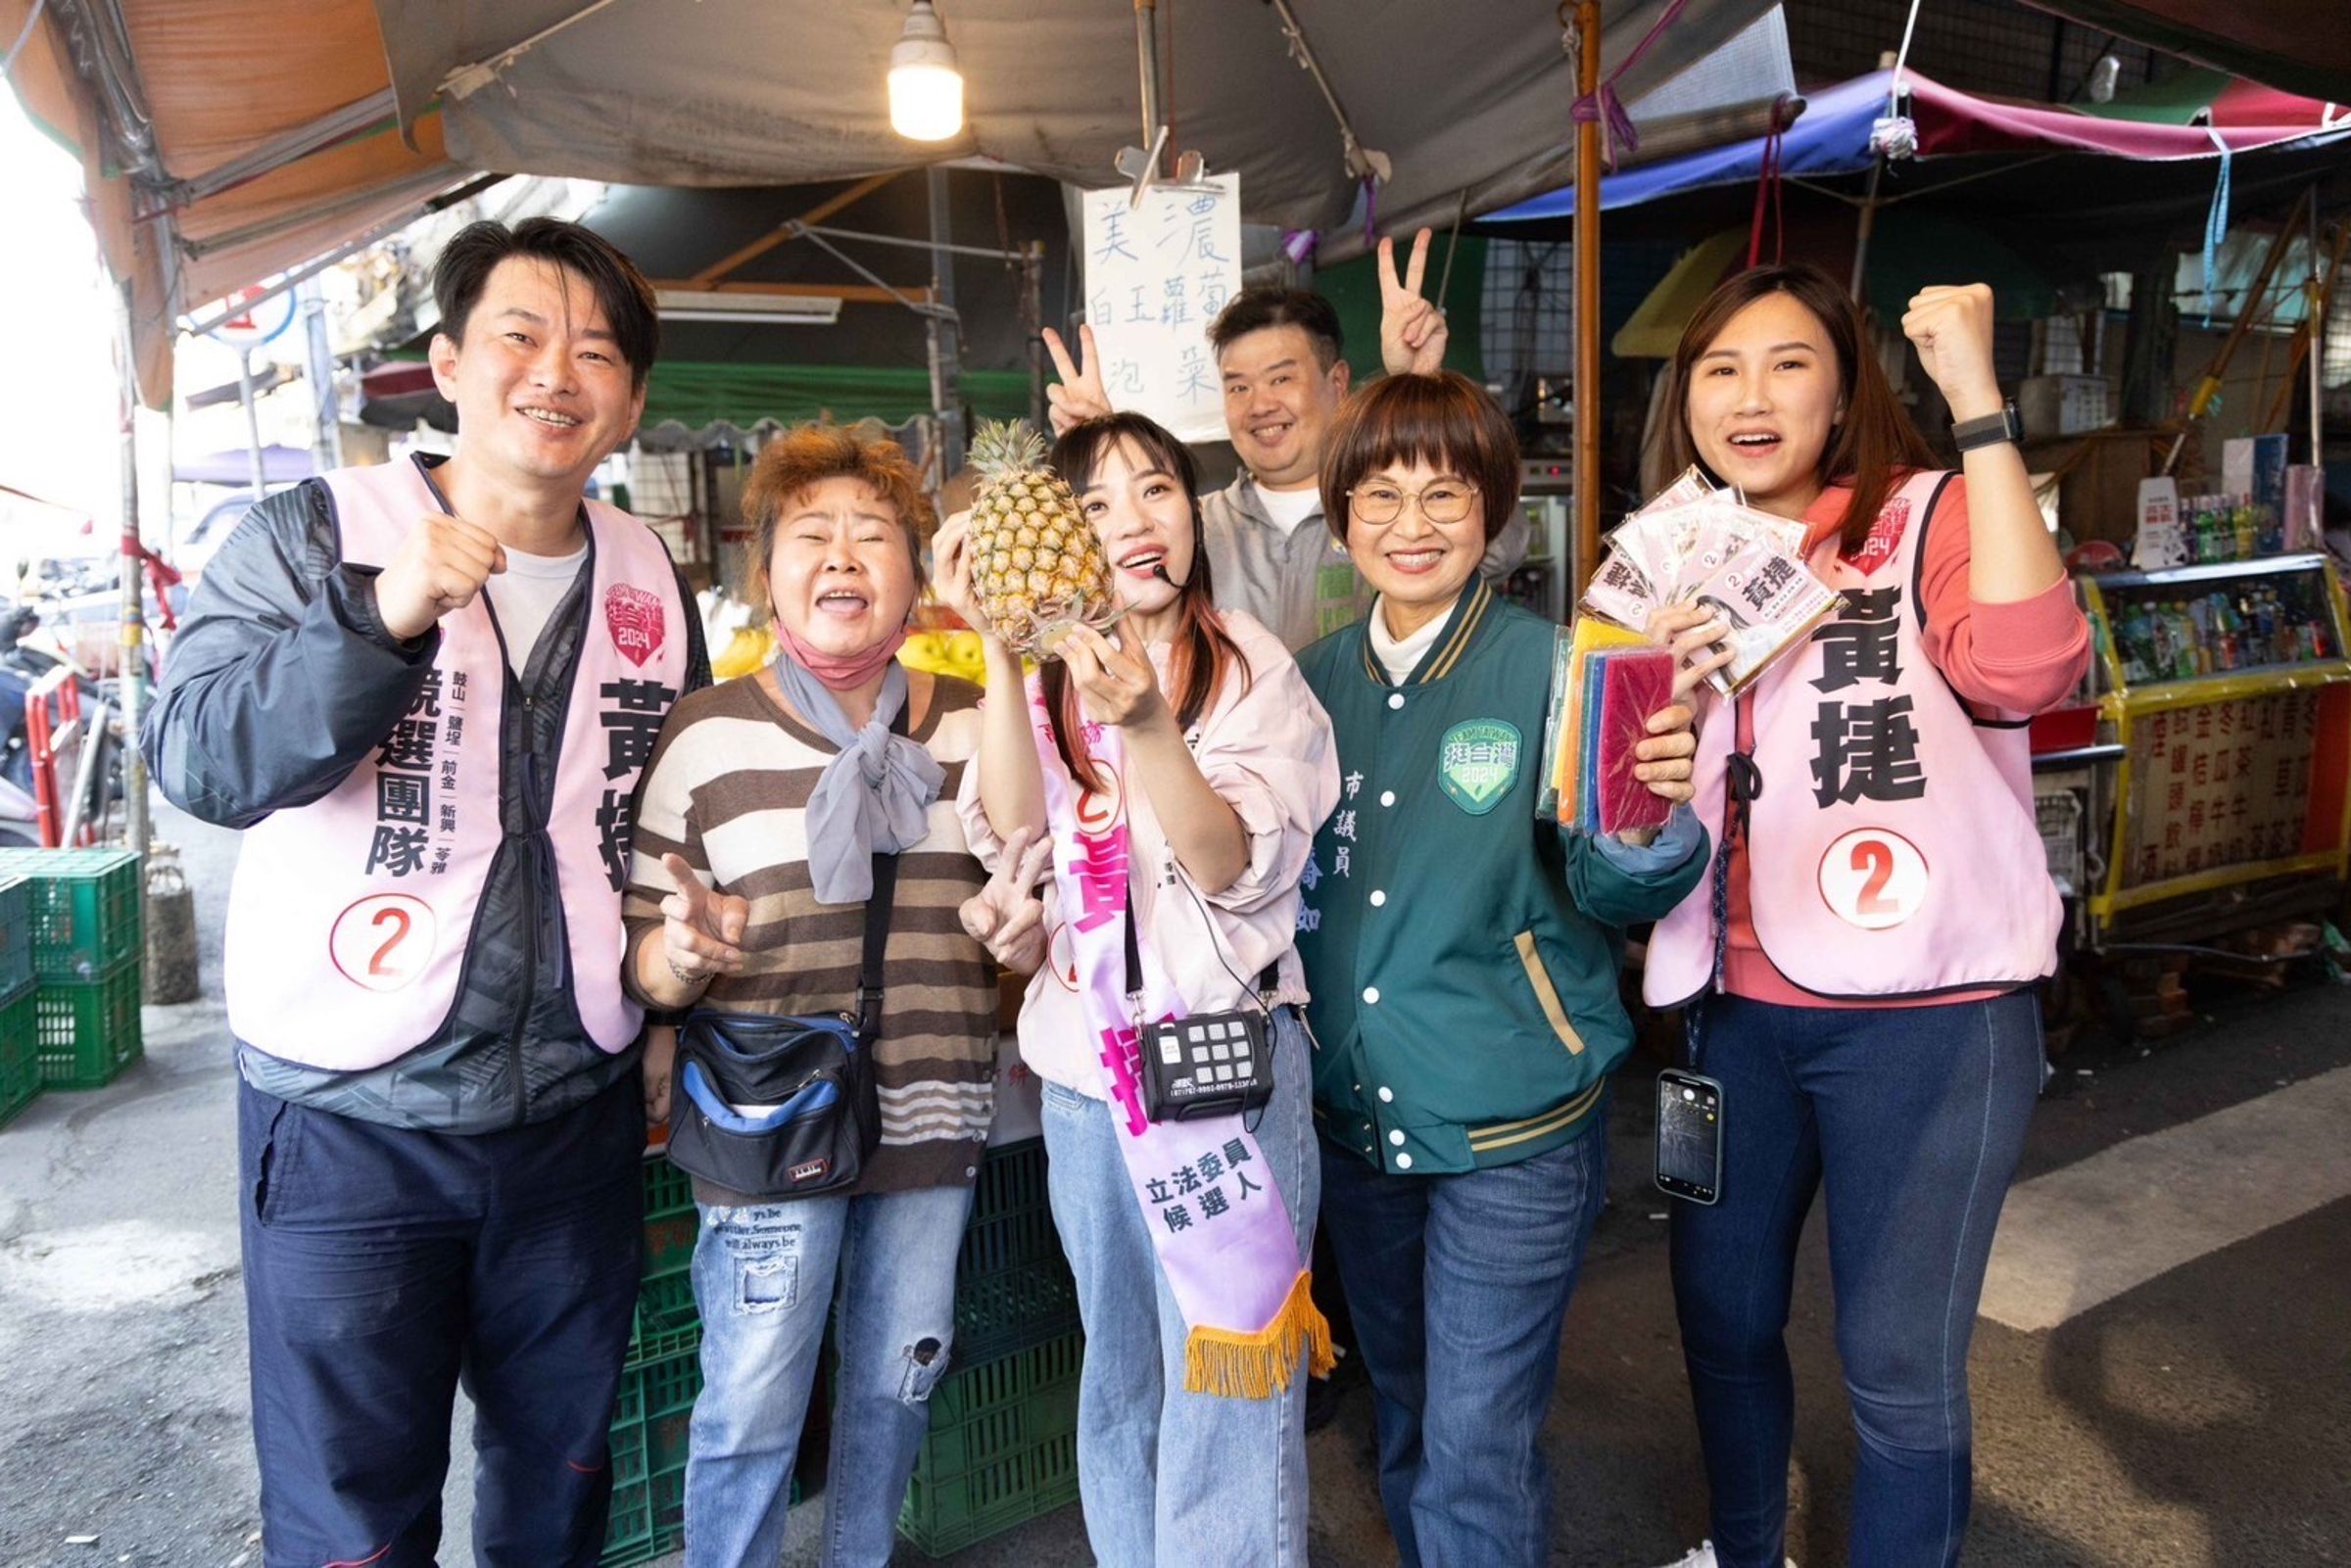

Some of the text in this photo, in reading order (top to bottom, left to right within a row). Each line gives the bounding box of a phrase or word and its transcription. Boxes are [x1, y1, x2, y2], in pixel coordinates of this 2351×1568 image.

[1094, 195, 1229, 265] 美濃
[1108, 346, 1218, 404] 泡菜
[1728, 575, 1741, 587] 2
[1742, 556, 1797, 612] 黃捷
[618, 627, 650, 649] 2024
[452, 671, 468, 701] 鼓山
[1808, 587, 1927, 809] 黃捷
[441, 760, 458, 790] 前金
[1444, 741, 1517, 773] 挺台灣
[1463, 767, 1498, 783] 2024
[440, 804, 456, 833] 新興
[1333, 770, 1364, 878] 市議員
[1850, 840, 1899, 914] 2
[368, 908, 410, 974] 2
[1145, 1137, 1253, 1206] 立法委員
[1162, 1170, 1262, 1234] 候選人
[742, 1237, 781, 1251] always
[782, 1235, 796, 1247] be
